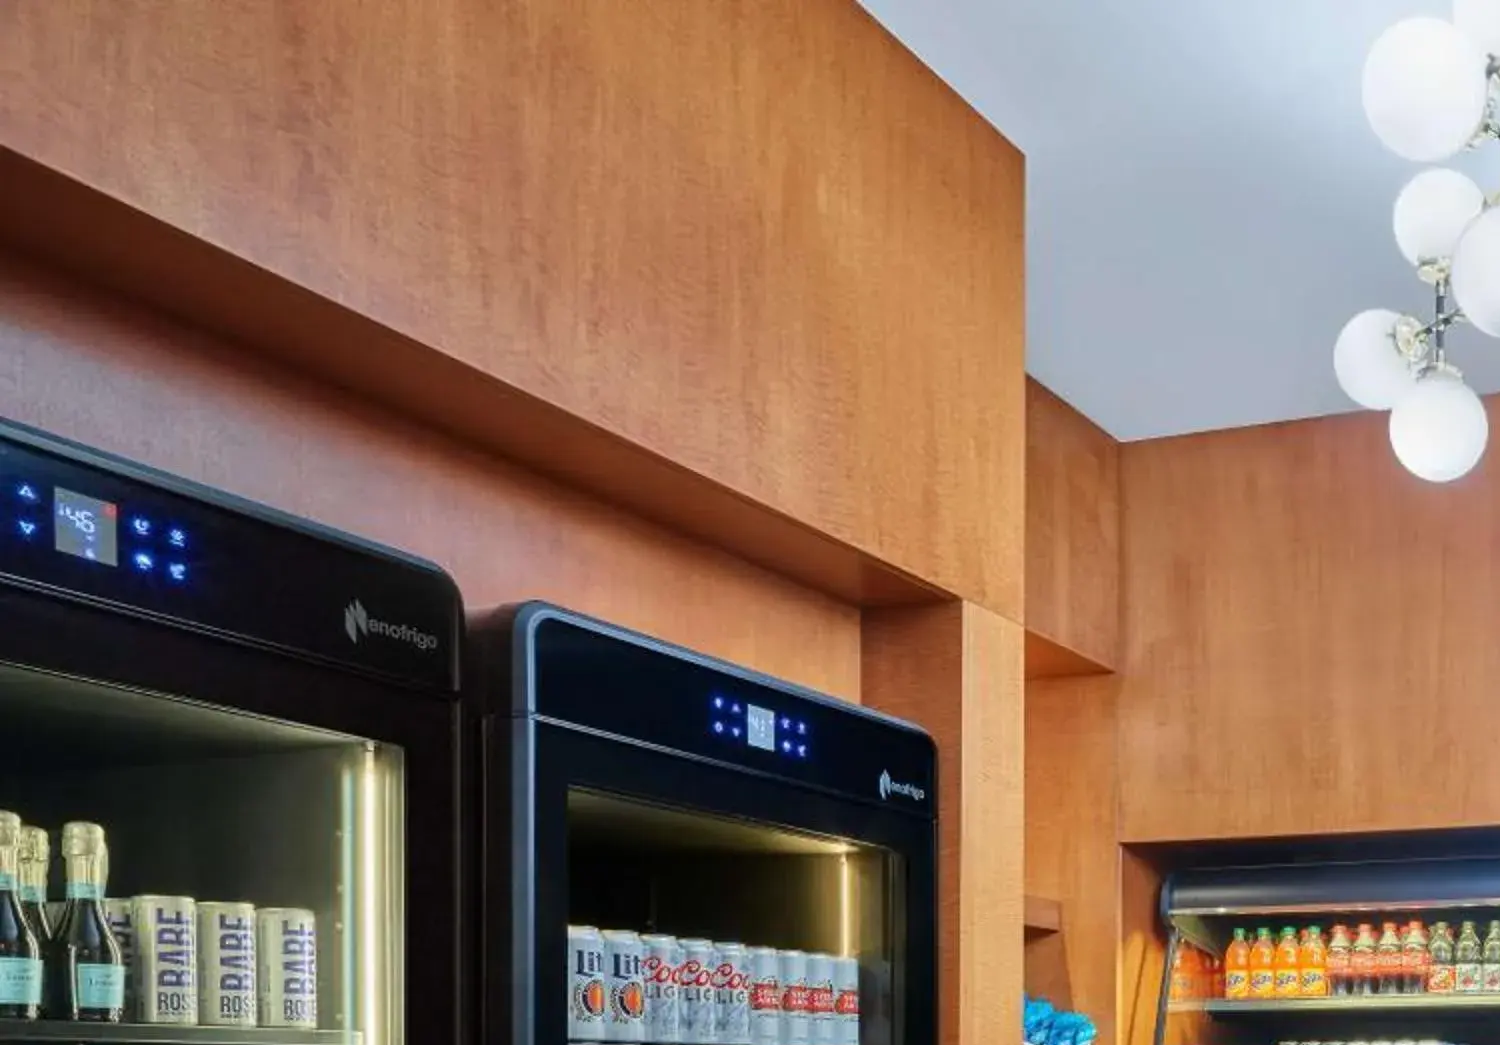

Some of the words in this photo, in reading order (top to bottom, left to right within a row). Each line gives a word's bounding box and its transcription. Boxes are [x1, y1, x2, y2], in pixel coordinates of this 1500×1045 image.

[368, 619, 438, 649] enofrigo
[157, 908, 190, 986] BARE
[576, 950, 603, 978] Lit
[612, 953, 641, 980] Lit
[158, 991, 192, 1011] ROS
[646, 985, 675, 999] LIG
[686, 987, 712, 1003] LIG
[717, 990, 745, 1004] LIG
[220, 995, 254, 1014] ROS
